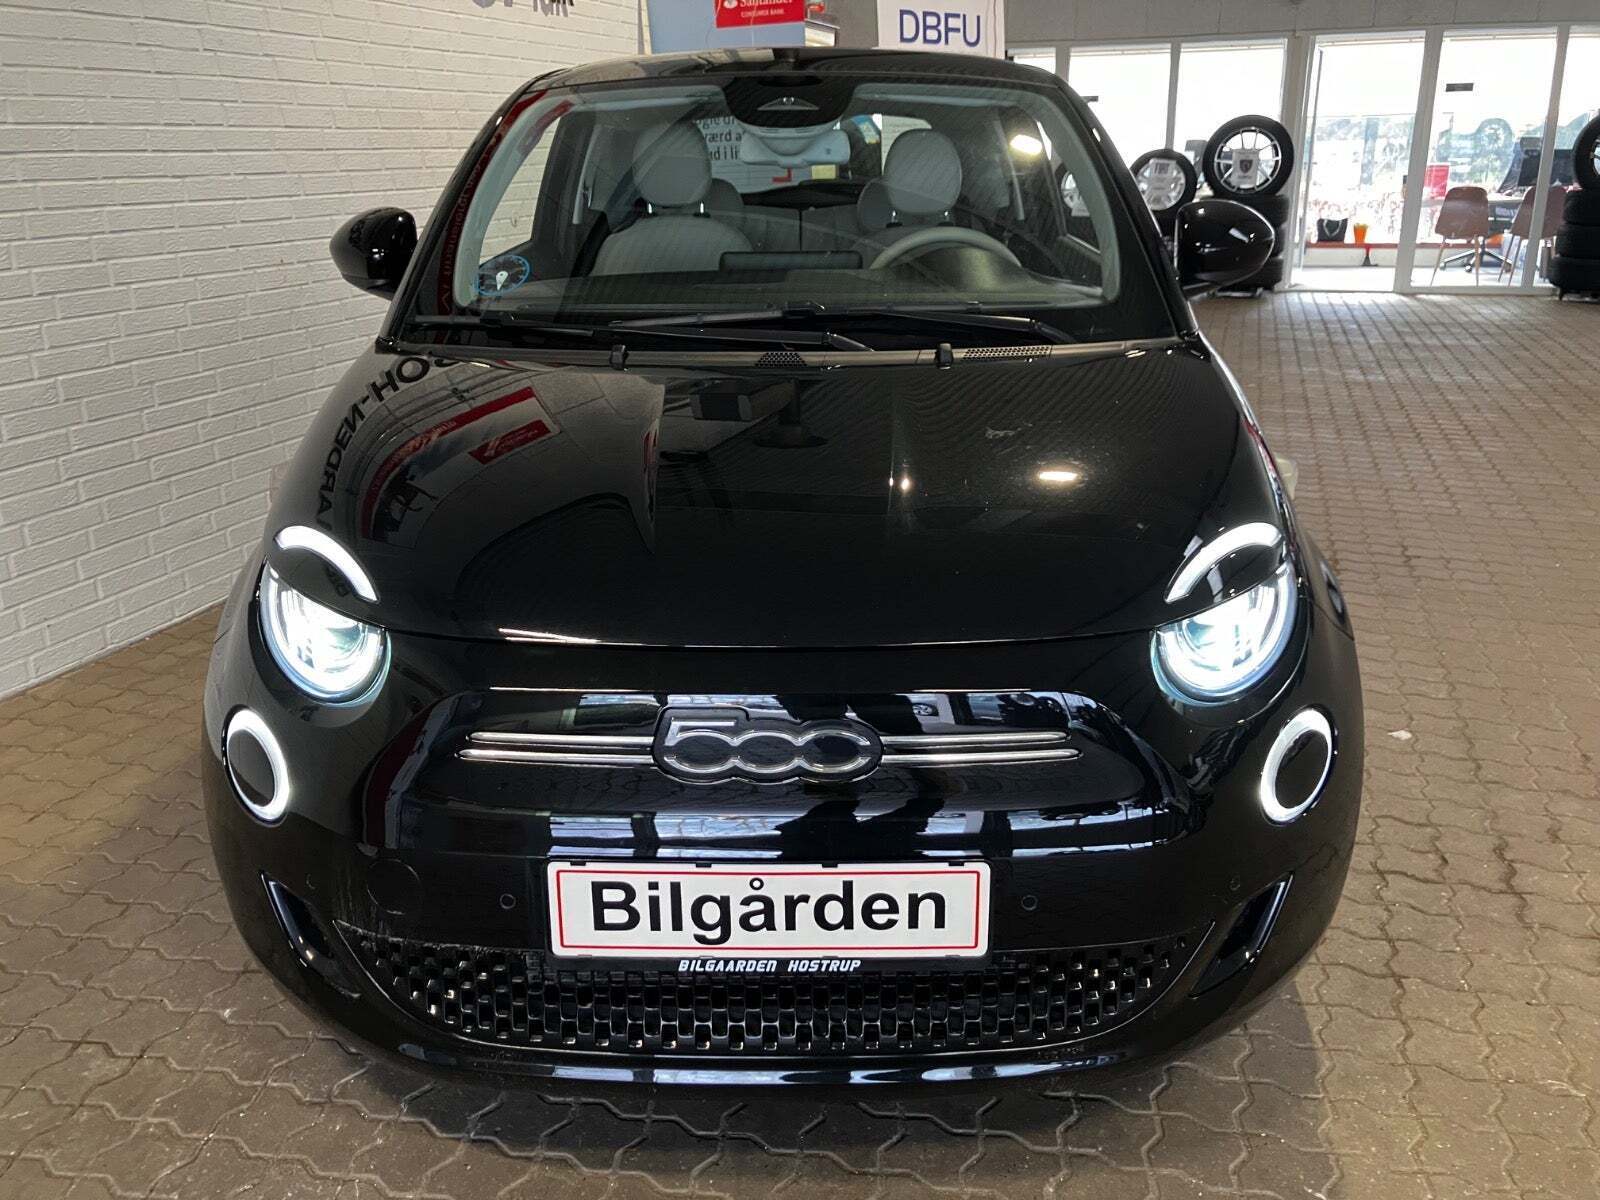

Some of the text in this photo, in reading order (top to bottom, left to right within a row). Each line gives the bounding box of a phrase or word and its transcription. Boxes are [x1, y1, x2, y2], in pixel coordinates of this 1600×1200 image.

[899, 9, 981, 47] DBFU
[663, 717, 872, 775] 500
[590, 876, 946, 946] Bilgården
[677, 958, 862, 973] BILGAARDEN HOSTRUP
